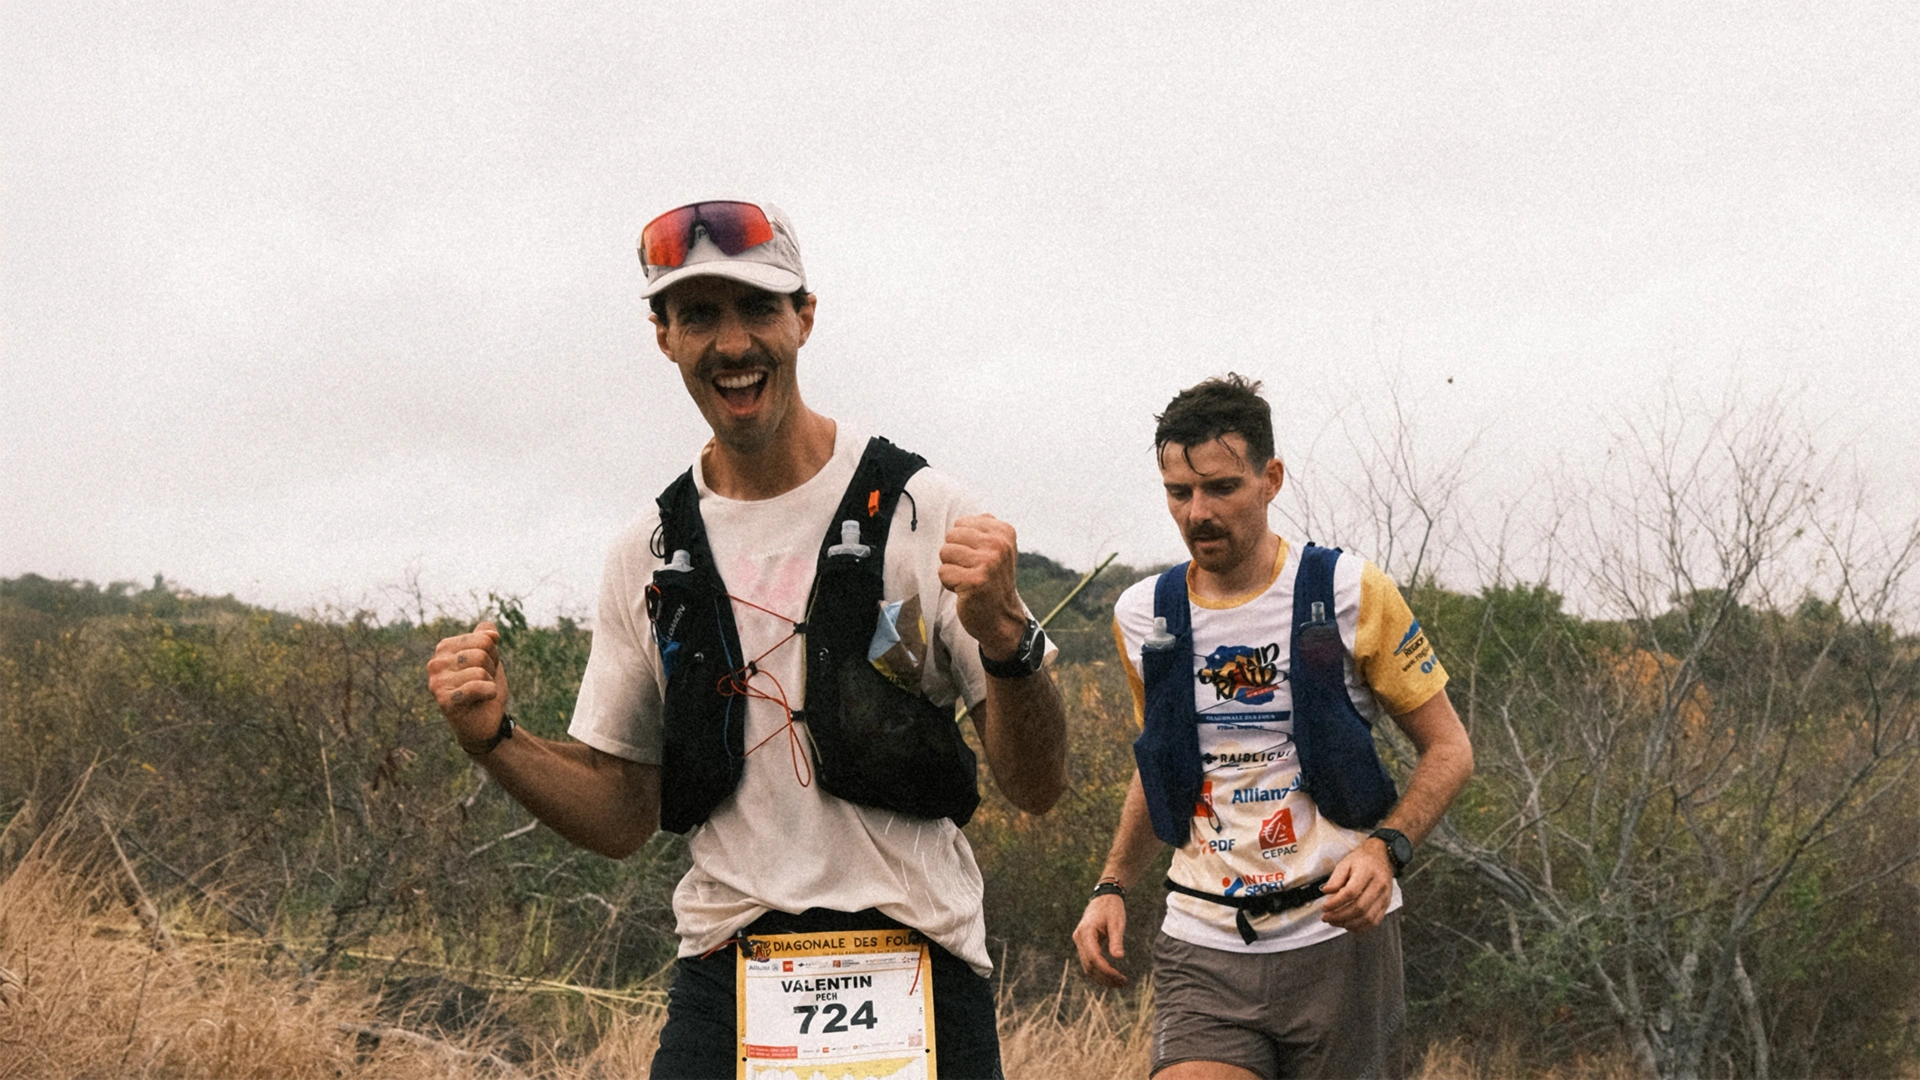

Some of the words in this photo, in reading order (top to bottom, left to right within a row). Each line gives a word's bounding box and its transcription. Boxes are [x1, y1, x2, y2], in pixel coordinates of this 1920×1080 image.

[1220, 750, 1291, 763] RAIDLIG
[1231, 787, 1289, 804] Allianz
[1262, 844, 1298, 860] CEPAC
[1241, 871, 1285, 886] INTER
[1245, 880, 1285, 897] SPORT
[773, 938, 846, 952] DIAGONALE
[853, 936, 878, 948] DES
[781, 975, 872, 993] VALENTIN
[815, 992, 838, 1001] PECH
[793, 1000, 878, 1034] 724
